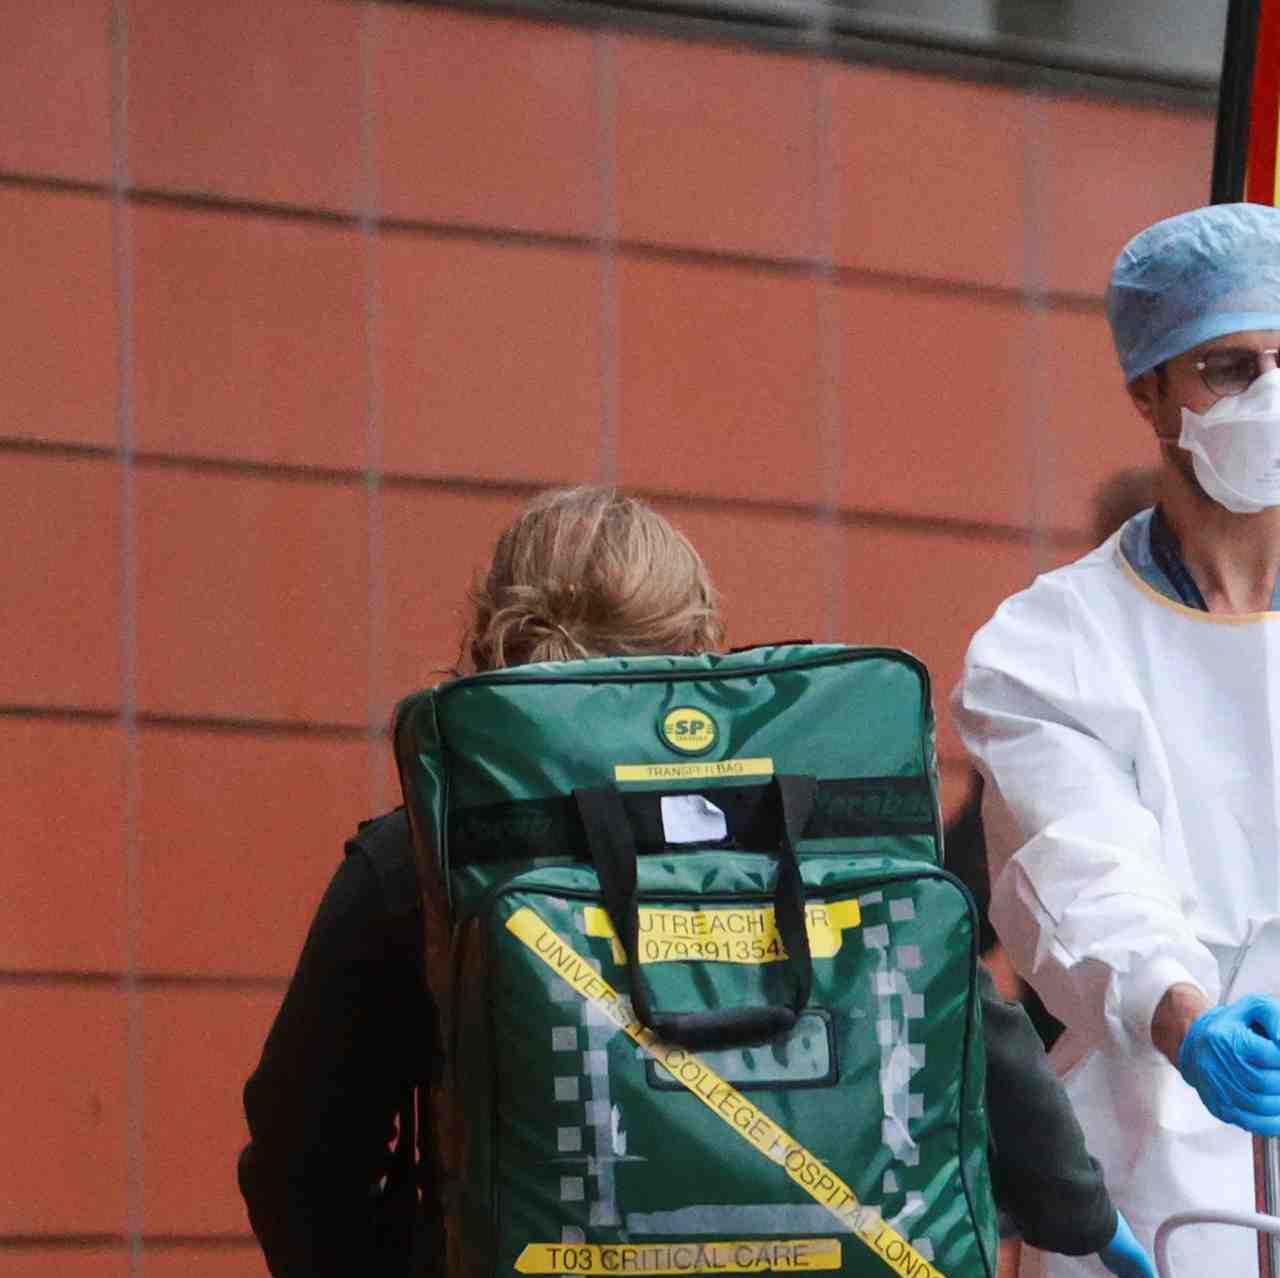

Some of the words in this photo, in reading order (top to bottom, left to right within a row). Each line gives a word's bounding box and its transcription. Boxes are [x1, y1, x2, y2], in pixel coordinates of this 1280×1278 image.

[675, 719, 706, 736] SP
[639, 911, 765, 936] UTREACH
[664, 1050, 771, 1142] COLLEGE
[547, 1246, 593, 1270] T03
[600, 1246, 727, 1270] CRITICAL
[734, 1244, 809, 1269] CARE
